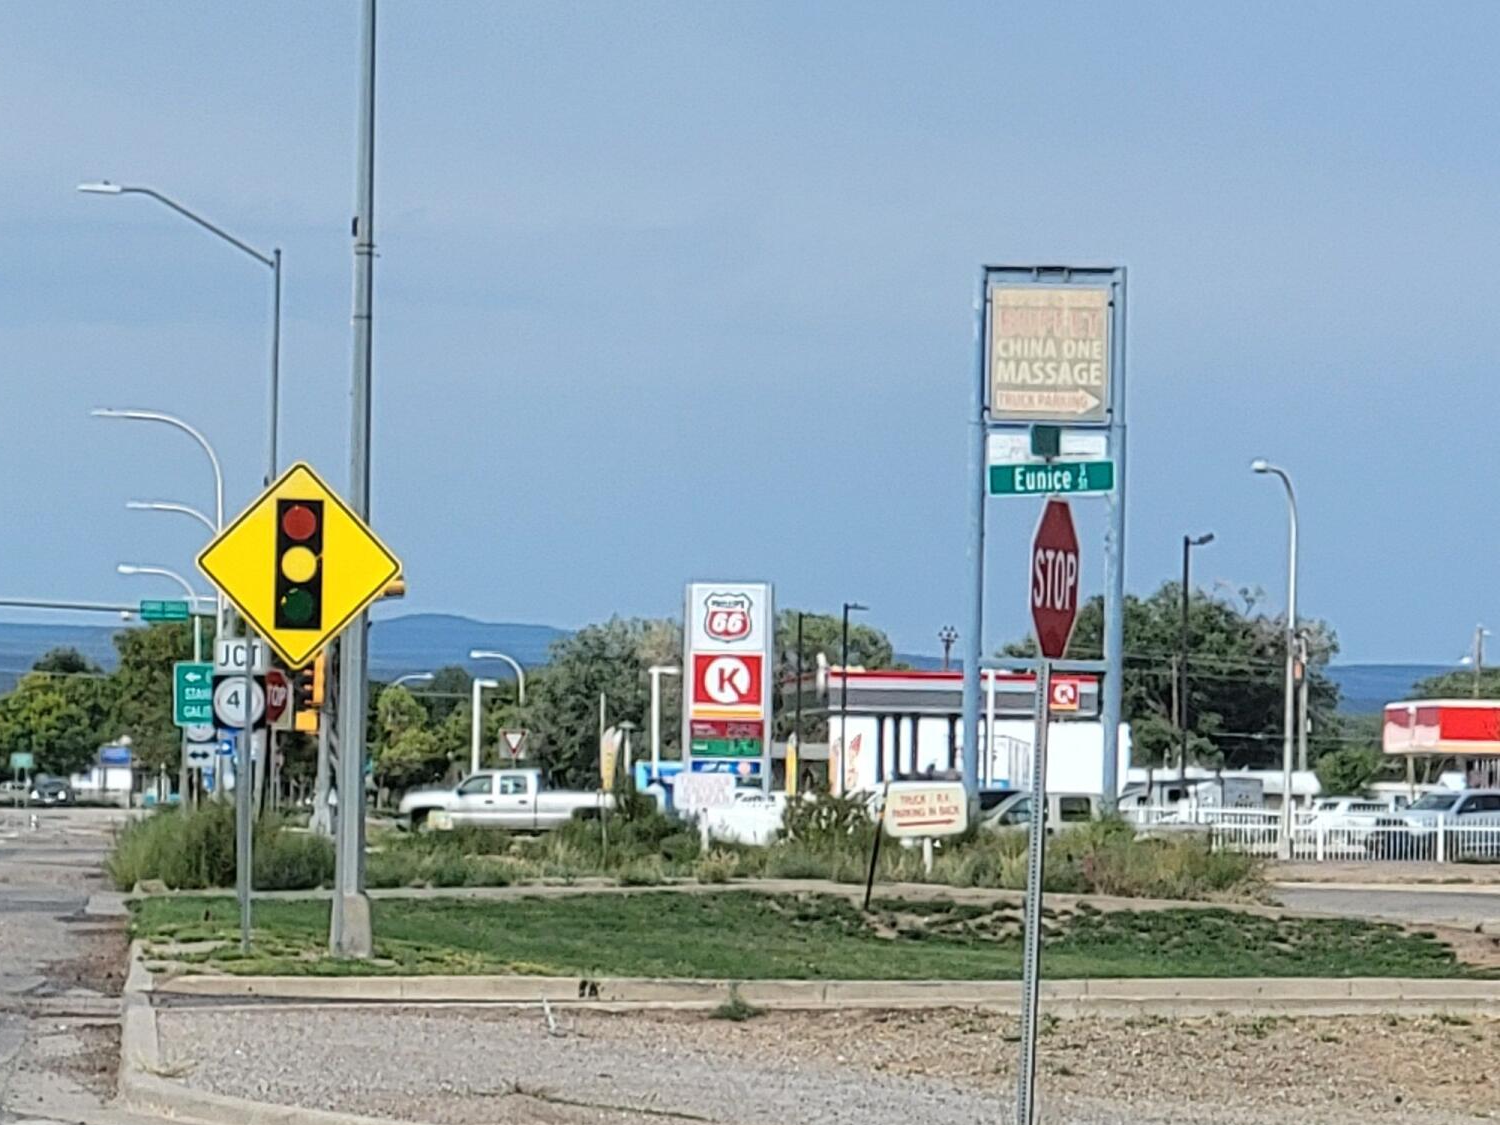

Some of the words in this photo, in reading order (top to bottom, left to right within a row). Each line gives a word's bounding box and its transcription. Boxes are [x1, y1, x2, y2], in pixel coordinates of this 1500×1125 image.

[998, 338, 1057, 358] CHINA
[1062, 339, 1103, 360] ONE
[997, 361, 1103, 386] MASSAGE
[1014, 466, 1073, 492] Eunice
[1033, 547, 1077, 611] STOP
[711, 612, 744, 633] 66
[219, 643, 259, 668] JCT
[226, 690, 241, 709] 4
